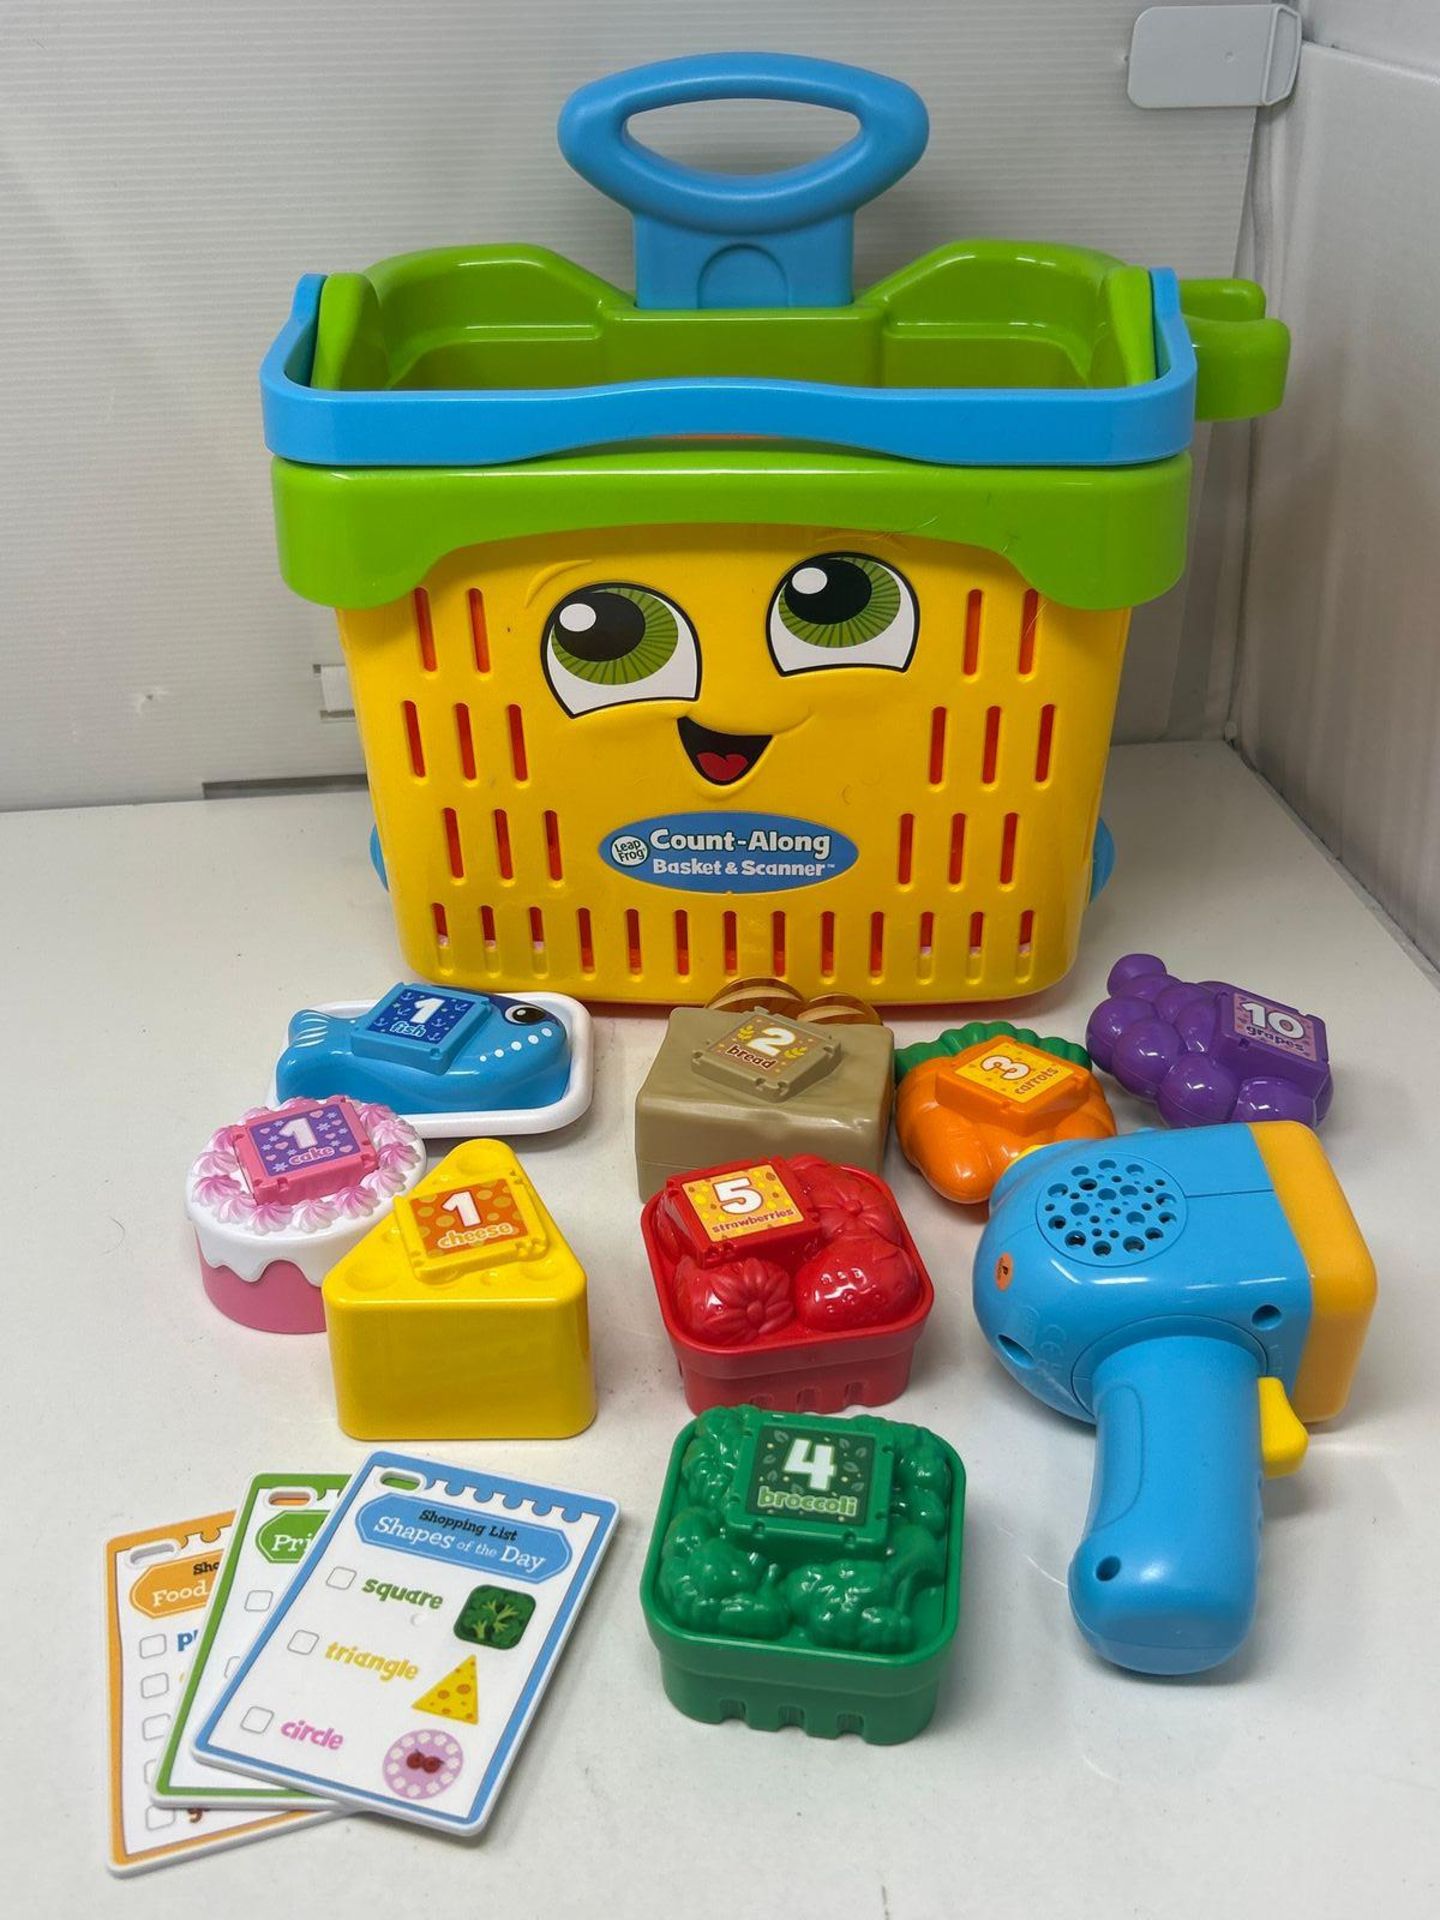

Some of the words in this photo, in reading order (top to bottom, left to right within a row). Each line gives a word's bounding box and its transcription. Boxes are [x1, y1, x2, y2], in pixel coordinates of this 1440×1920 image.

[614, 839, 641, 853] Leap
[649, 828, 830, 860] Count-Along
[653, 858, 721, 876] Basket
[725, 861, 738, 875] &
[409, 998, 445, 1024] 1
[1240, 1002, 1305, 1040] 10
[390, 1020, 427, 1037] fish
[746, 1027, 796, 1057] 2
[1246, 1026, 1304, 1051] grapes
[725, 1044, 777, 1069] bread
[981, 1055, 1031, 1080] 3
[1015, 1067, 1059, 1095] carrots
[279, 1117, 318, 1149] 1
[288, 1146, 335, 1165] cake
[441, 1191, 482, 1227] 1
[713, 1177, 763, 1215] 5
[437, 1222, 513, 1248] cheese
[712, 1208, 794, 1233] strawberries
[783, 1438, 837, 1491] 4
[757, 1485, 858, 1517] broccoli
[418, 1508, 486, 1536] Shopping
[489, 1526, 518, 1542] List
[374, 1515, 455, 1549] Shapes
[456, 1540, 473, 1552] of
[474, 1541, 497, 1559] the
[500, 1545, 546, 1573] Day
[152, 1579, 209, 1607] Food
[362, 1578, 443, 1609] square
[324, 1641, 420, 1682] triangle
[280, 1719, 344, 1750] circle
